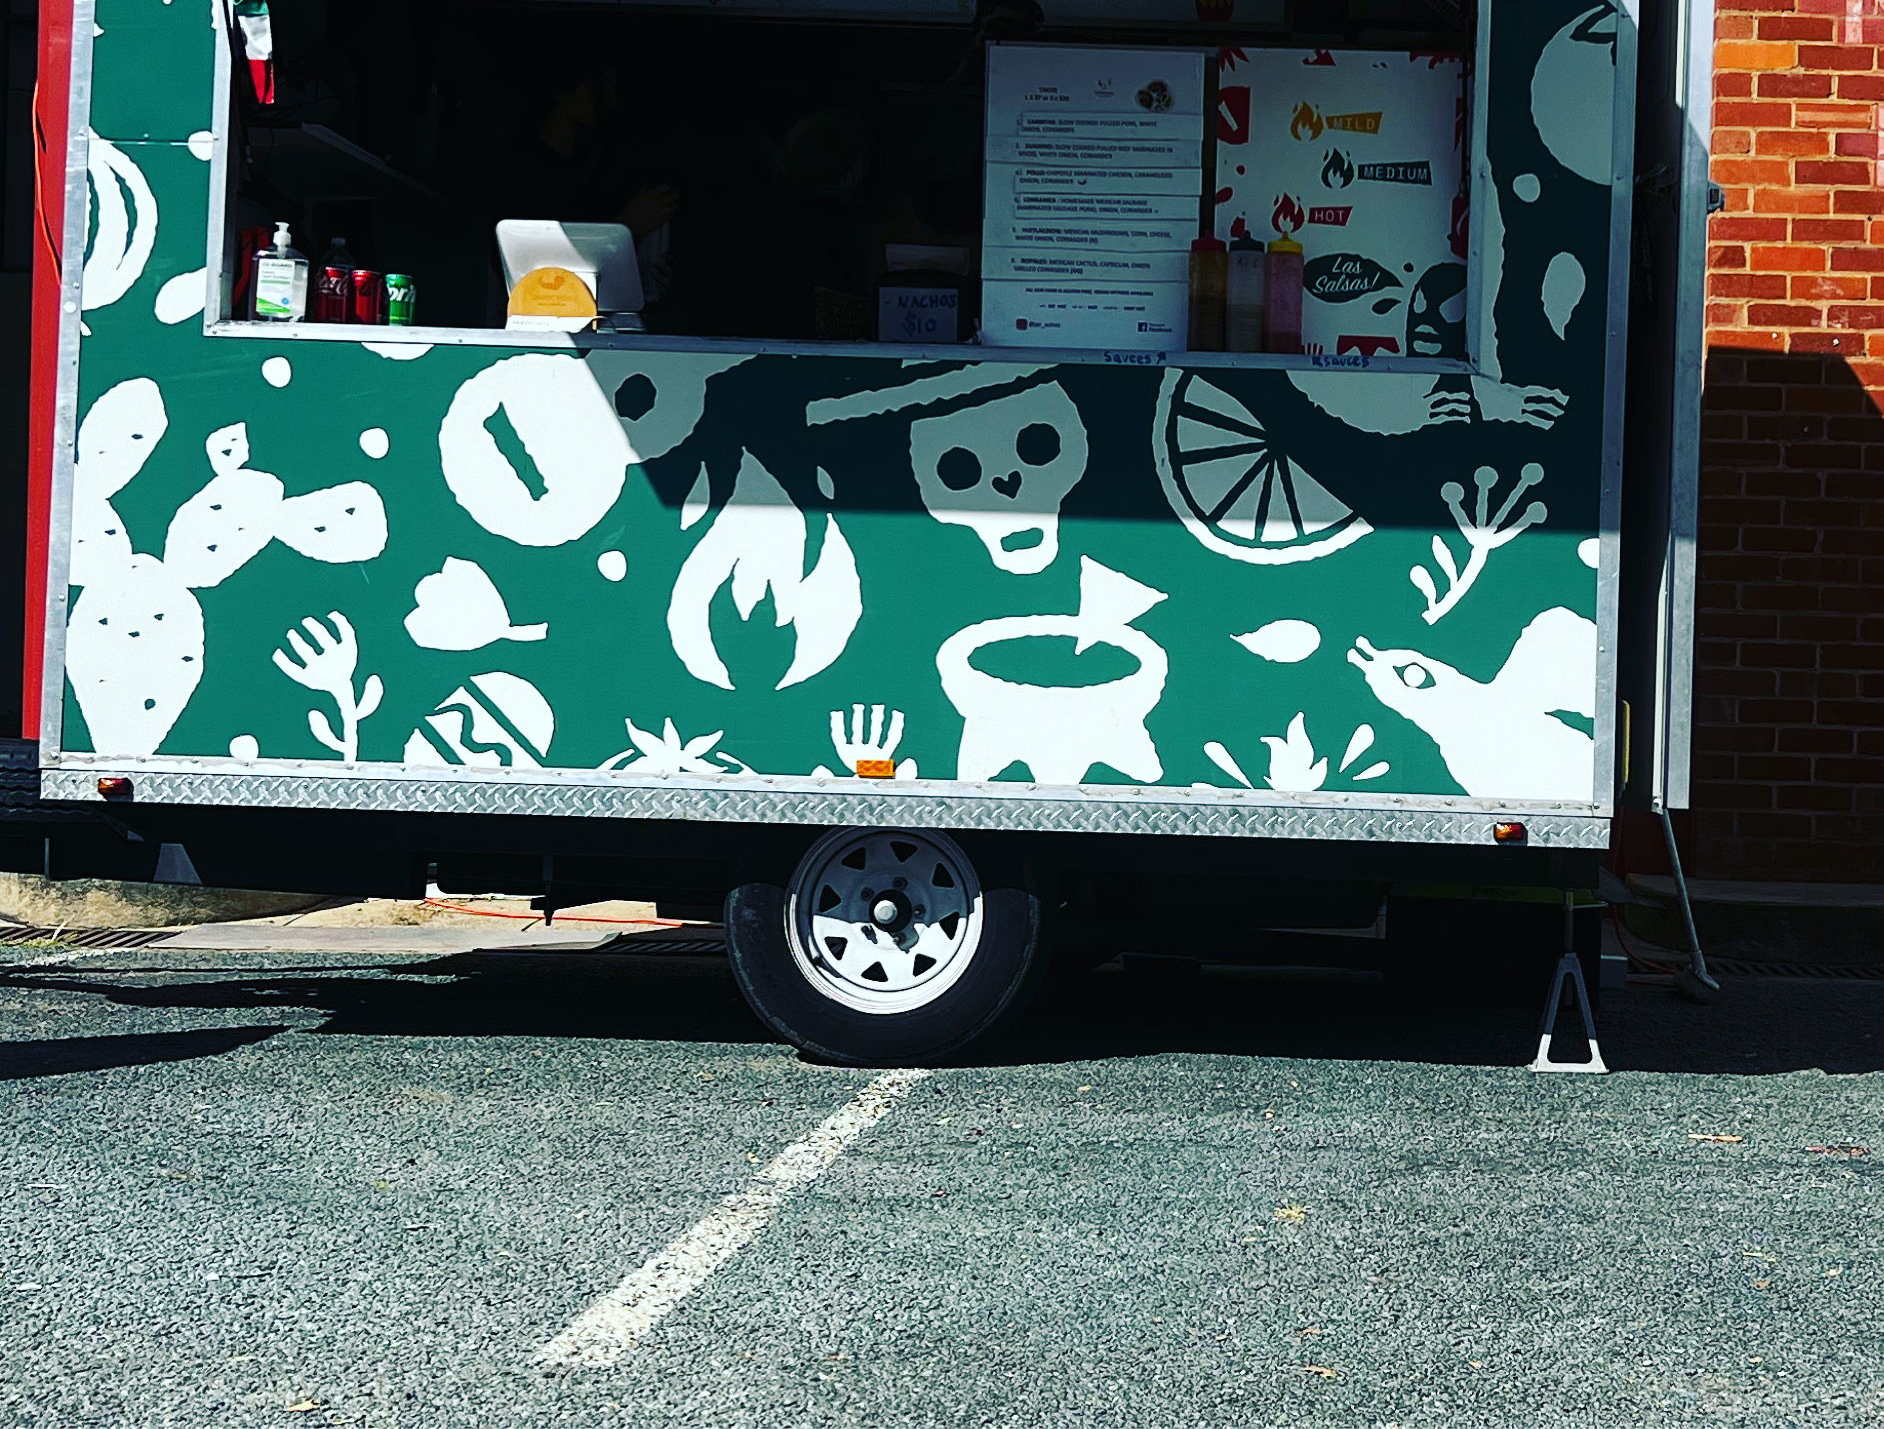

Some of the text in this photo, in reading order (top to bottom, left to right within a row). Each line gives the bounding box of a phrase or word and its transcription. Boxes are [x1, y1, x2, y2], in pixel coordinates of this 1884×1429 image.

[1332, 117, 1375, 130] MILD
[1363, 162, 1428, 180] MEDIUM
[1314, 209, 1346, 222] HOT
[1332, 255, 1363, 274] Las
[1311, 272, 1380, 294] Salsas!
[897, 294, 959, 309] NACHOS
[902, 310, 937, 338] $10
